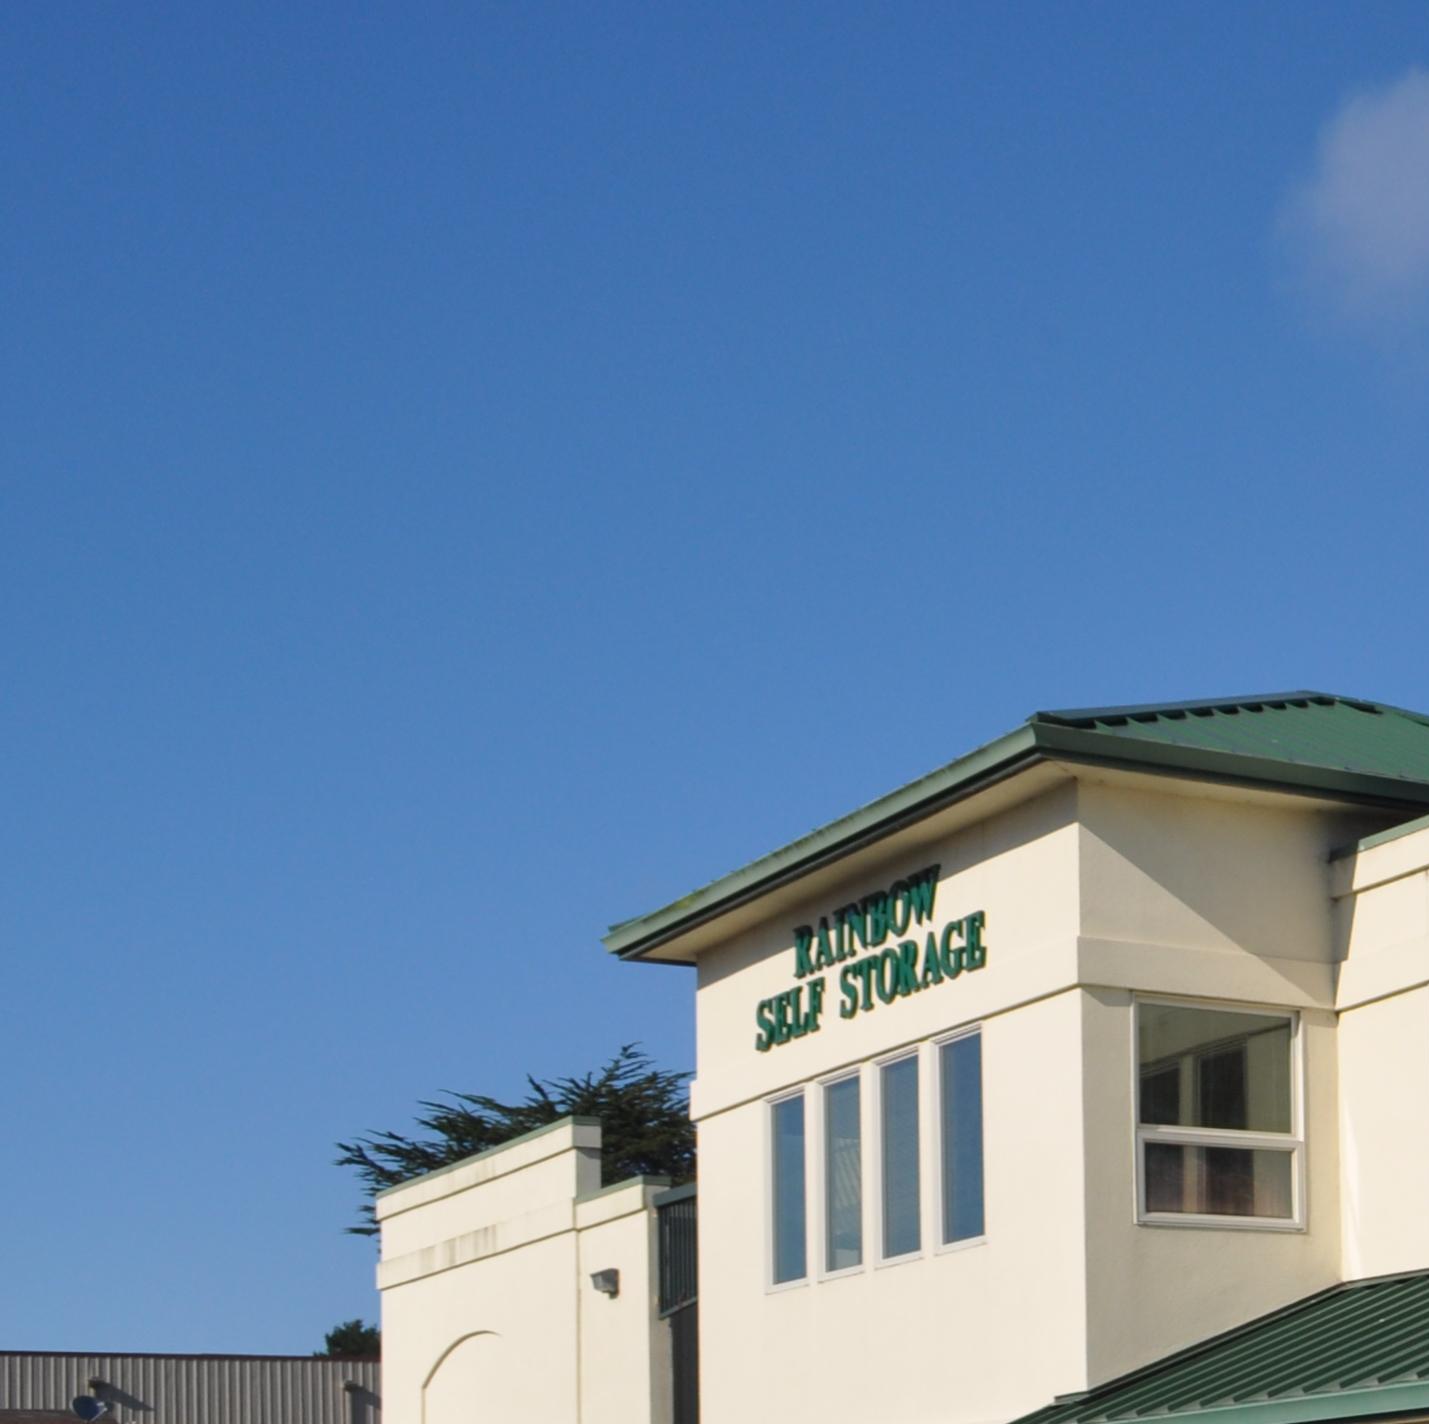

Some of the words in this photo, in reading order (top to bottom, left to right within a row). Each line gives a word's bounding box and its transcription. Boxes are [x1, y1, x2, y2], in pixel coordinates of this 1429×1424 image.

[755, 977, 825, 1052] SELF
[839, 910, 987, 1019] STORAGE
[793, 864, 941, 979] RAINBOW
